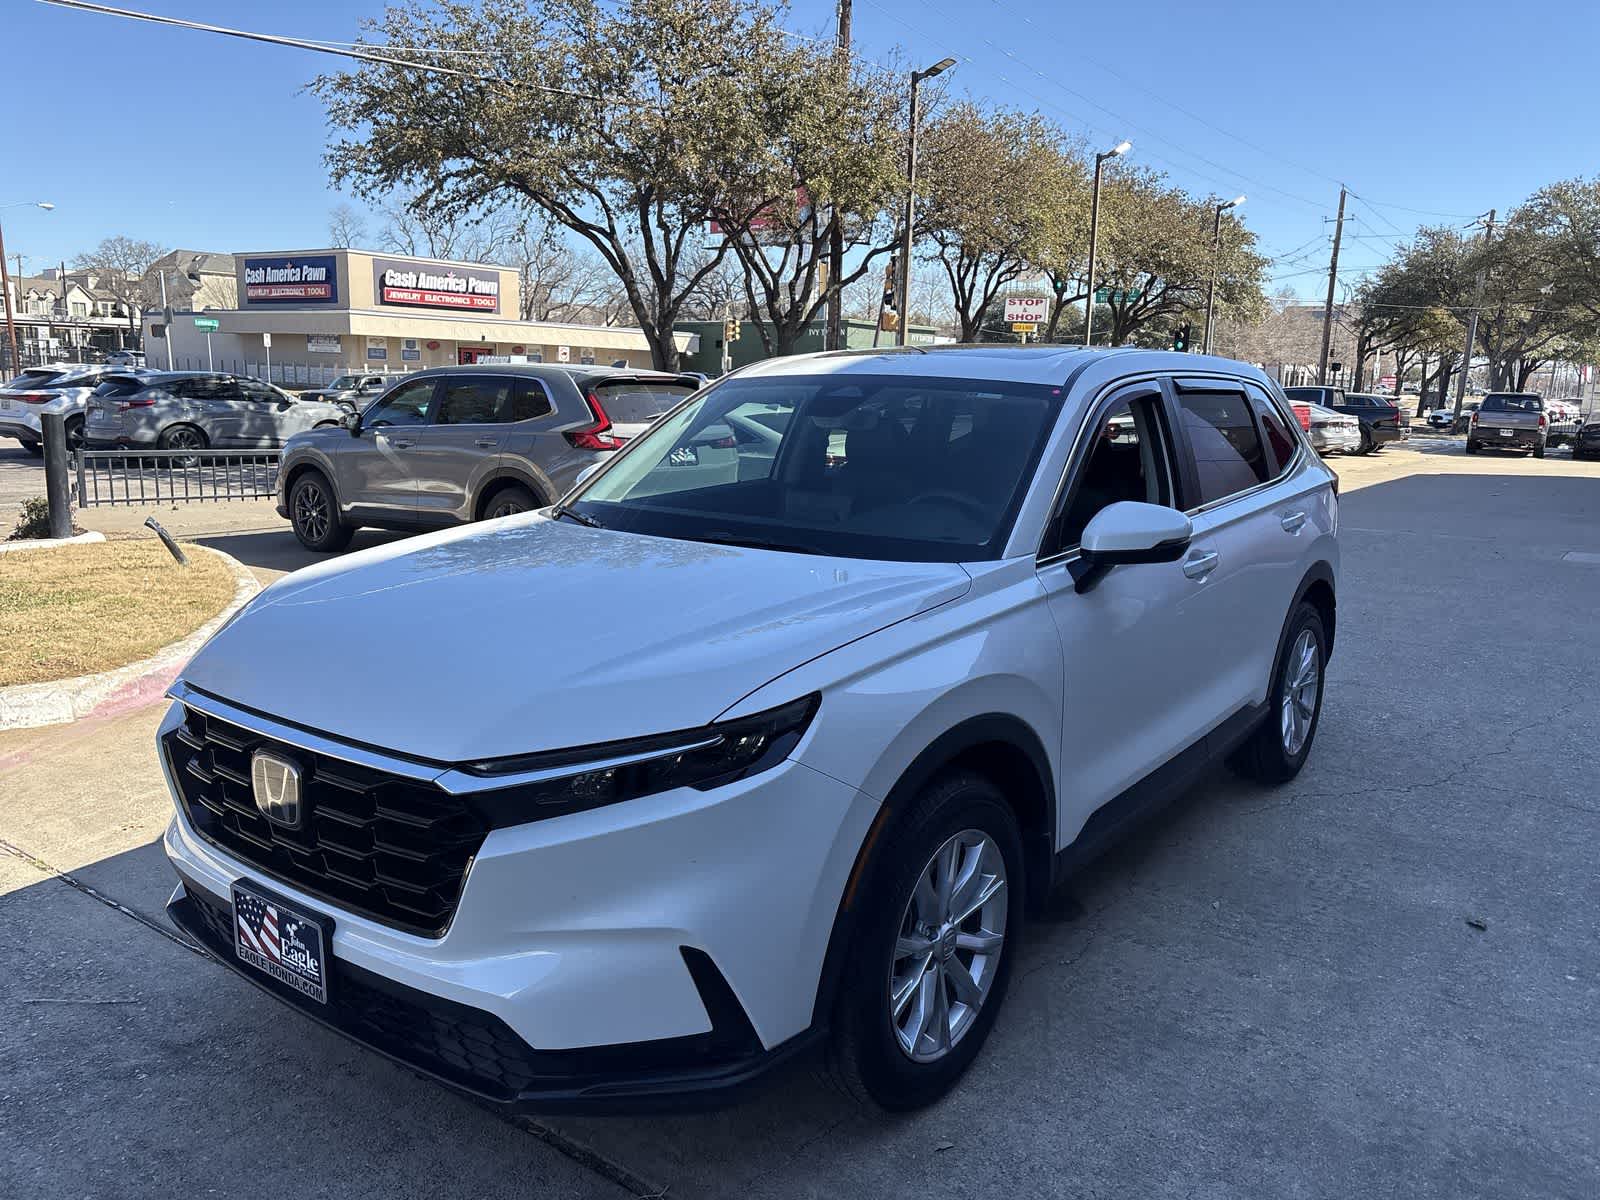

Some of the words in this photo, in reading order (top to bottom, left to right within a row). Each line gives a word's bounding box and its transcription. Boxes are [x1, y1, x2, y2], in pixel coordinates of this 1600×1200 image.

[245, 267, 265, 284] Cash
[266, 265, 300, 282] America
[302, 265, 326, 281] Pawn
[385, 269, 417, 288] Cash
[417, 271, 467, 293] America
[468, 277, 498, 295] Pawn
[271, 287, 305, 296] ELECTRONICS
[307, 287, 326, 296] TOOLS
[388, 291, 421, 301] JEWELRY
[424, 294, 471, 305] ELECTRONICS
[473, 298, 495, 306] TOOLS
[1007, 313, 1042, 321] SHOP
[808, 328, 820, 336] IVY
[290, 936, 305, 950] John
[280, 937, 319, 972] Eagle
